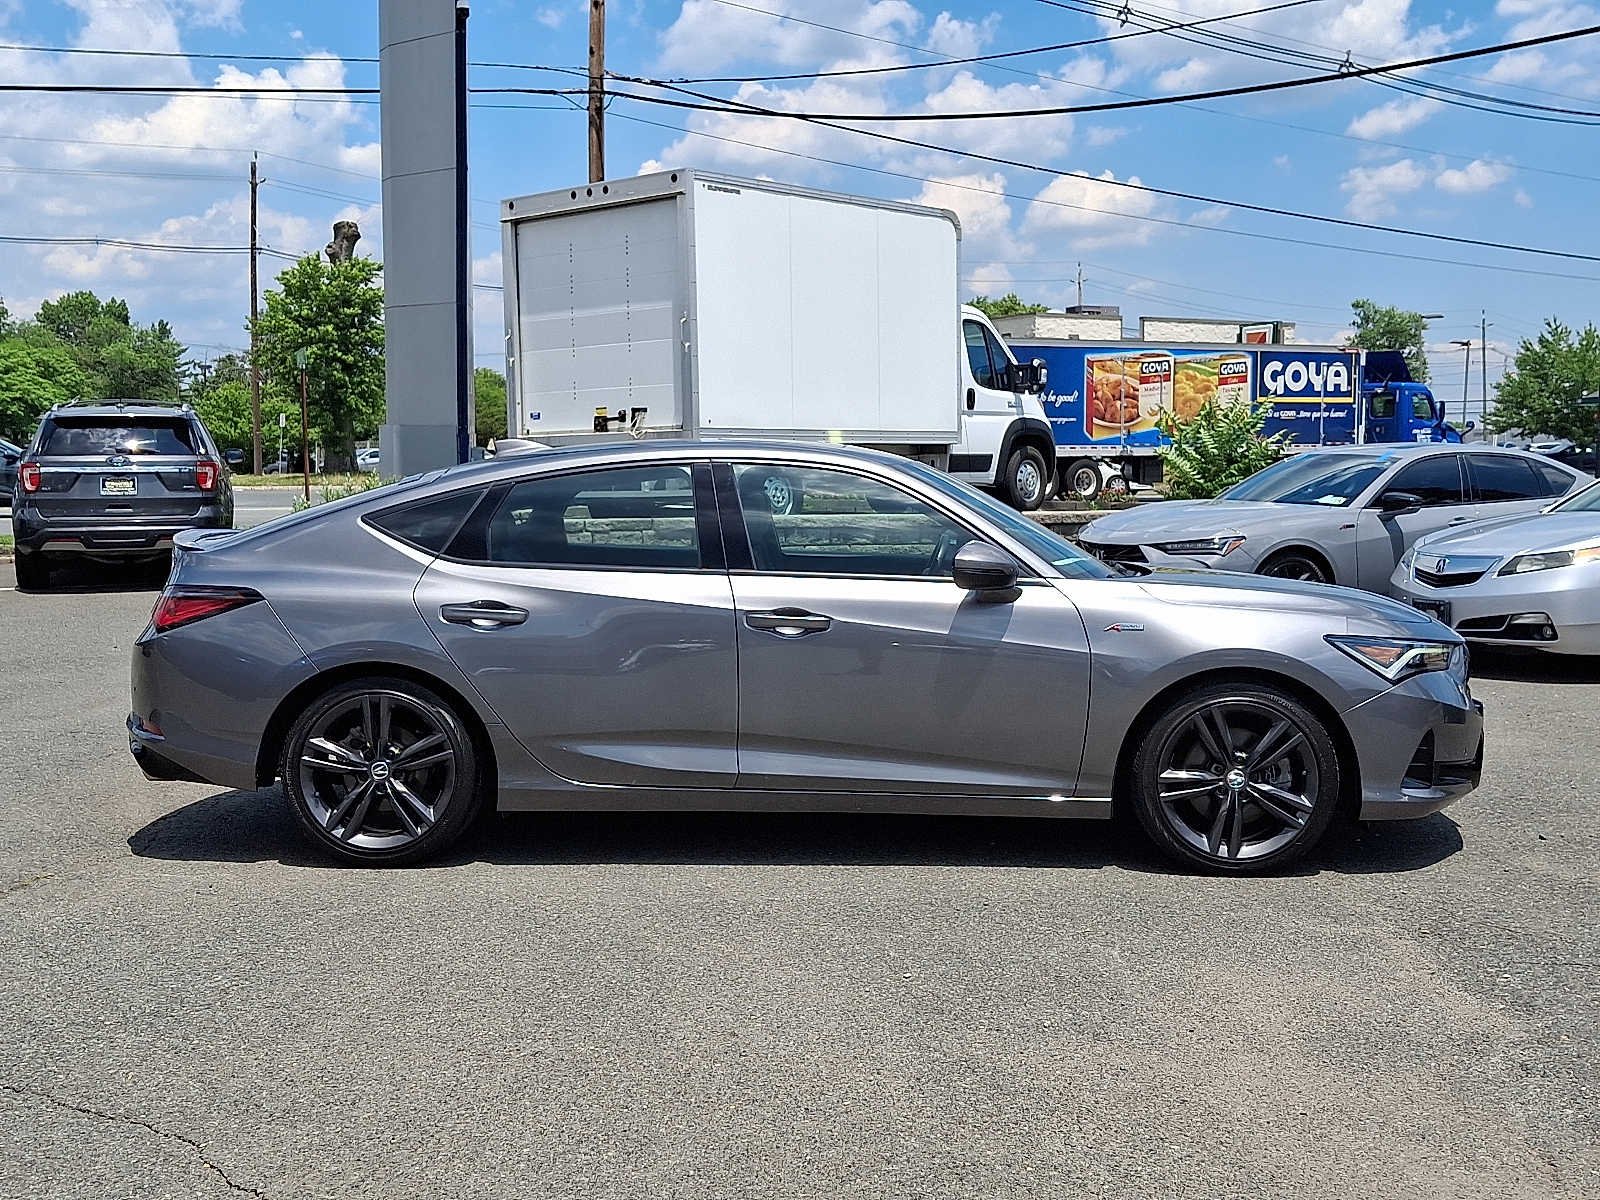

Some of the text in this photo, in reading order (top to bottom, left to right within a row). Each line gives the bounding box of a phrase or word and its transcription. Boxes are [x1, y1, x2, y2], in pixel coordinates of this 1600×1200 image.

[1142, 361, 1169, 373] GOYA
[1221, 363, 1246, 375] GOYA
[1263, 361, 1348, 395] GOYA
[1047, 389, 1056, 402] be
[1055, 389, 1079, 408] good!
